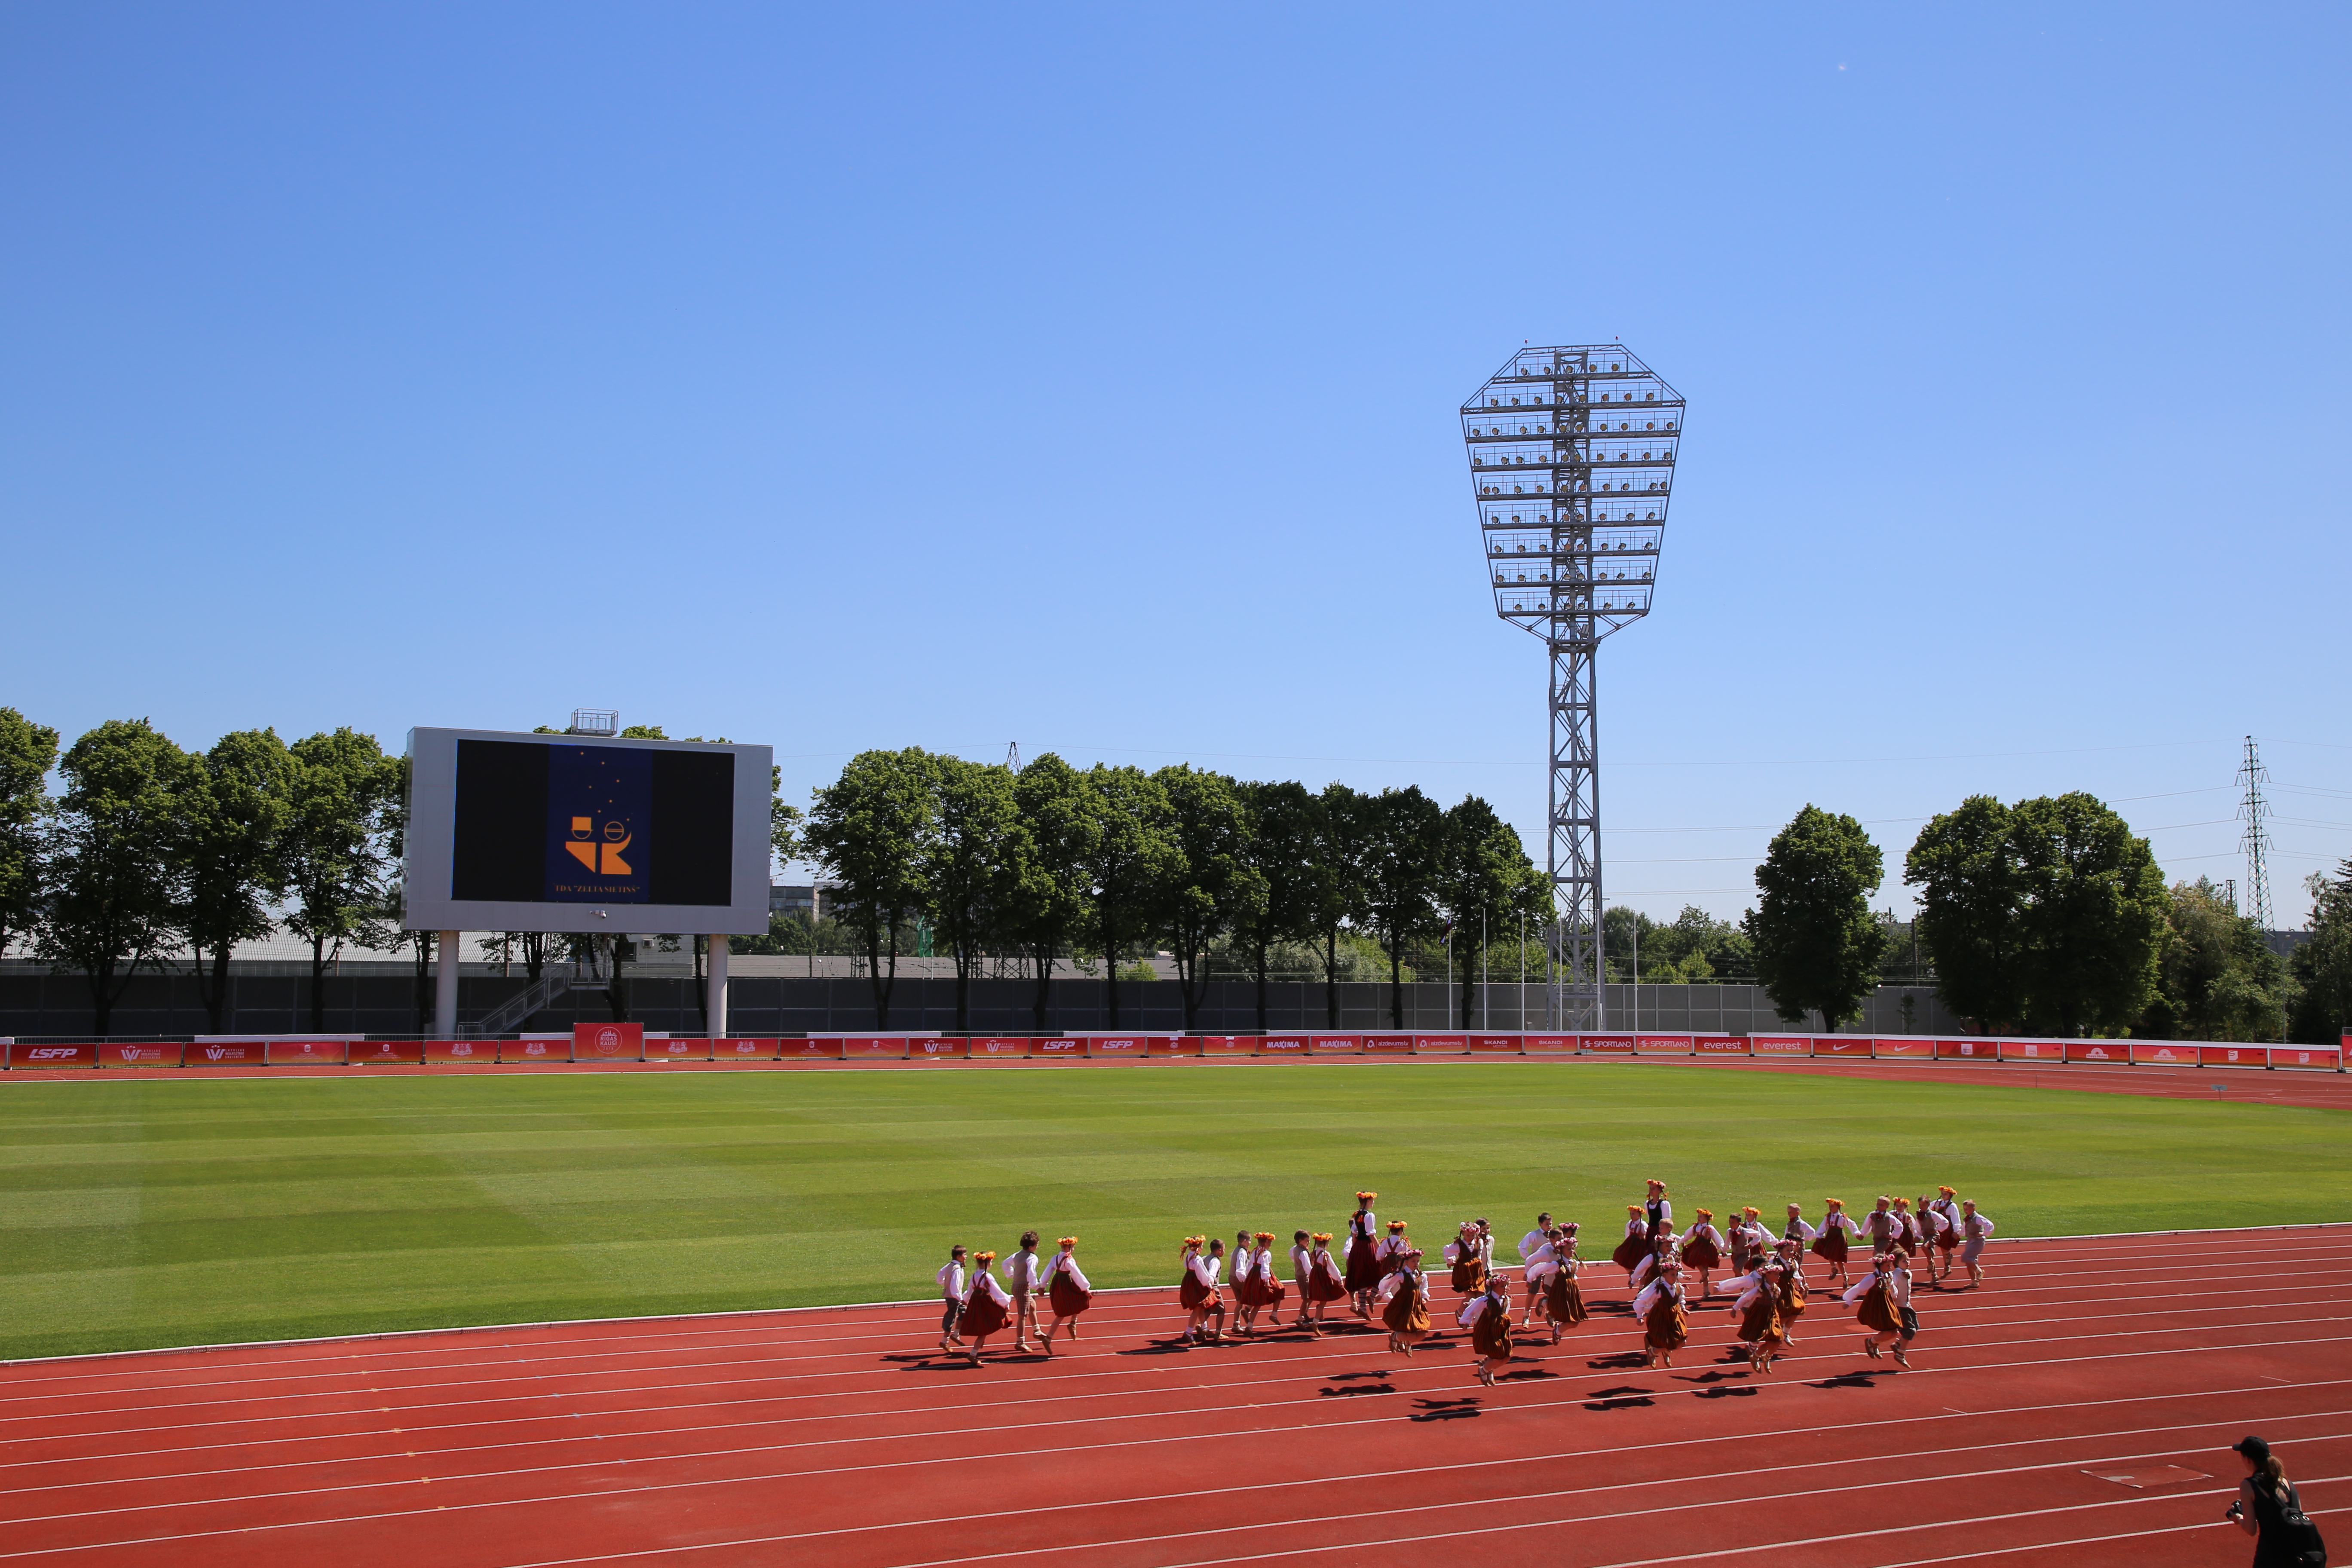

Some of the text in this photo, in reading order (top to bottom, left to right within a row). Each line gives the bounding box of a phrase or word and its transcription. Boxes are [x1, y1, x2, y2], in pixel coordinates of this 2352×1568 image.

[1043, 1041, 1075, 1049] LSFP
[1102, 1041, 1134, 1049] LSFP
[1267, 1040, 1300, 1049] MAXIMA
[1320, 1040, 1353, 1048] MAXIMA
[1704, 1041, 1742, 1049] everest
[1763, 1042, 1801, 1050] everest
[28, 1049, 77, 1059] LSFP
